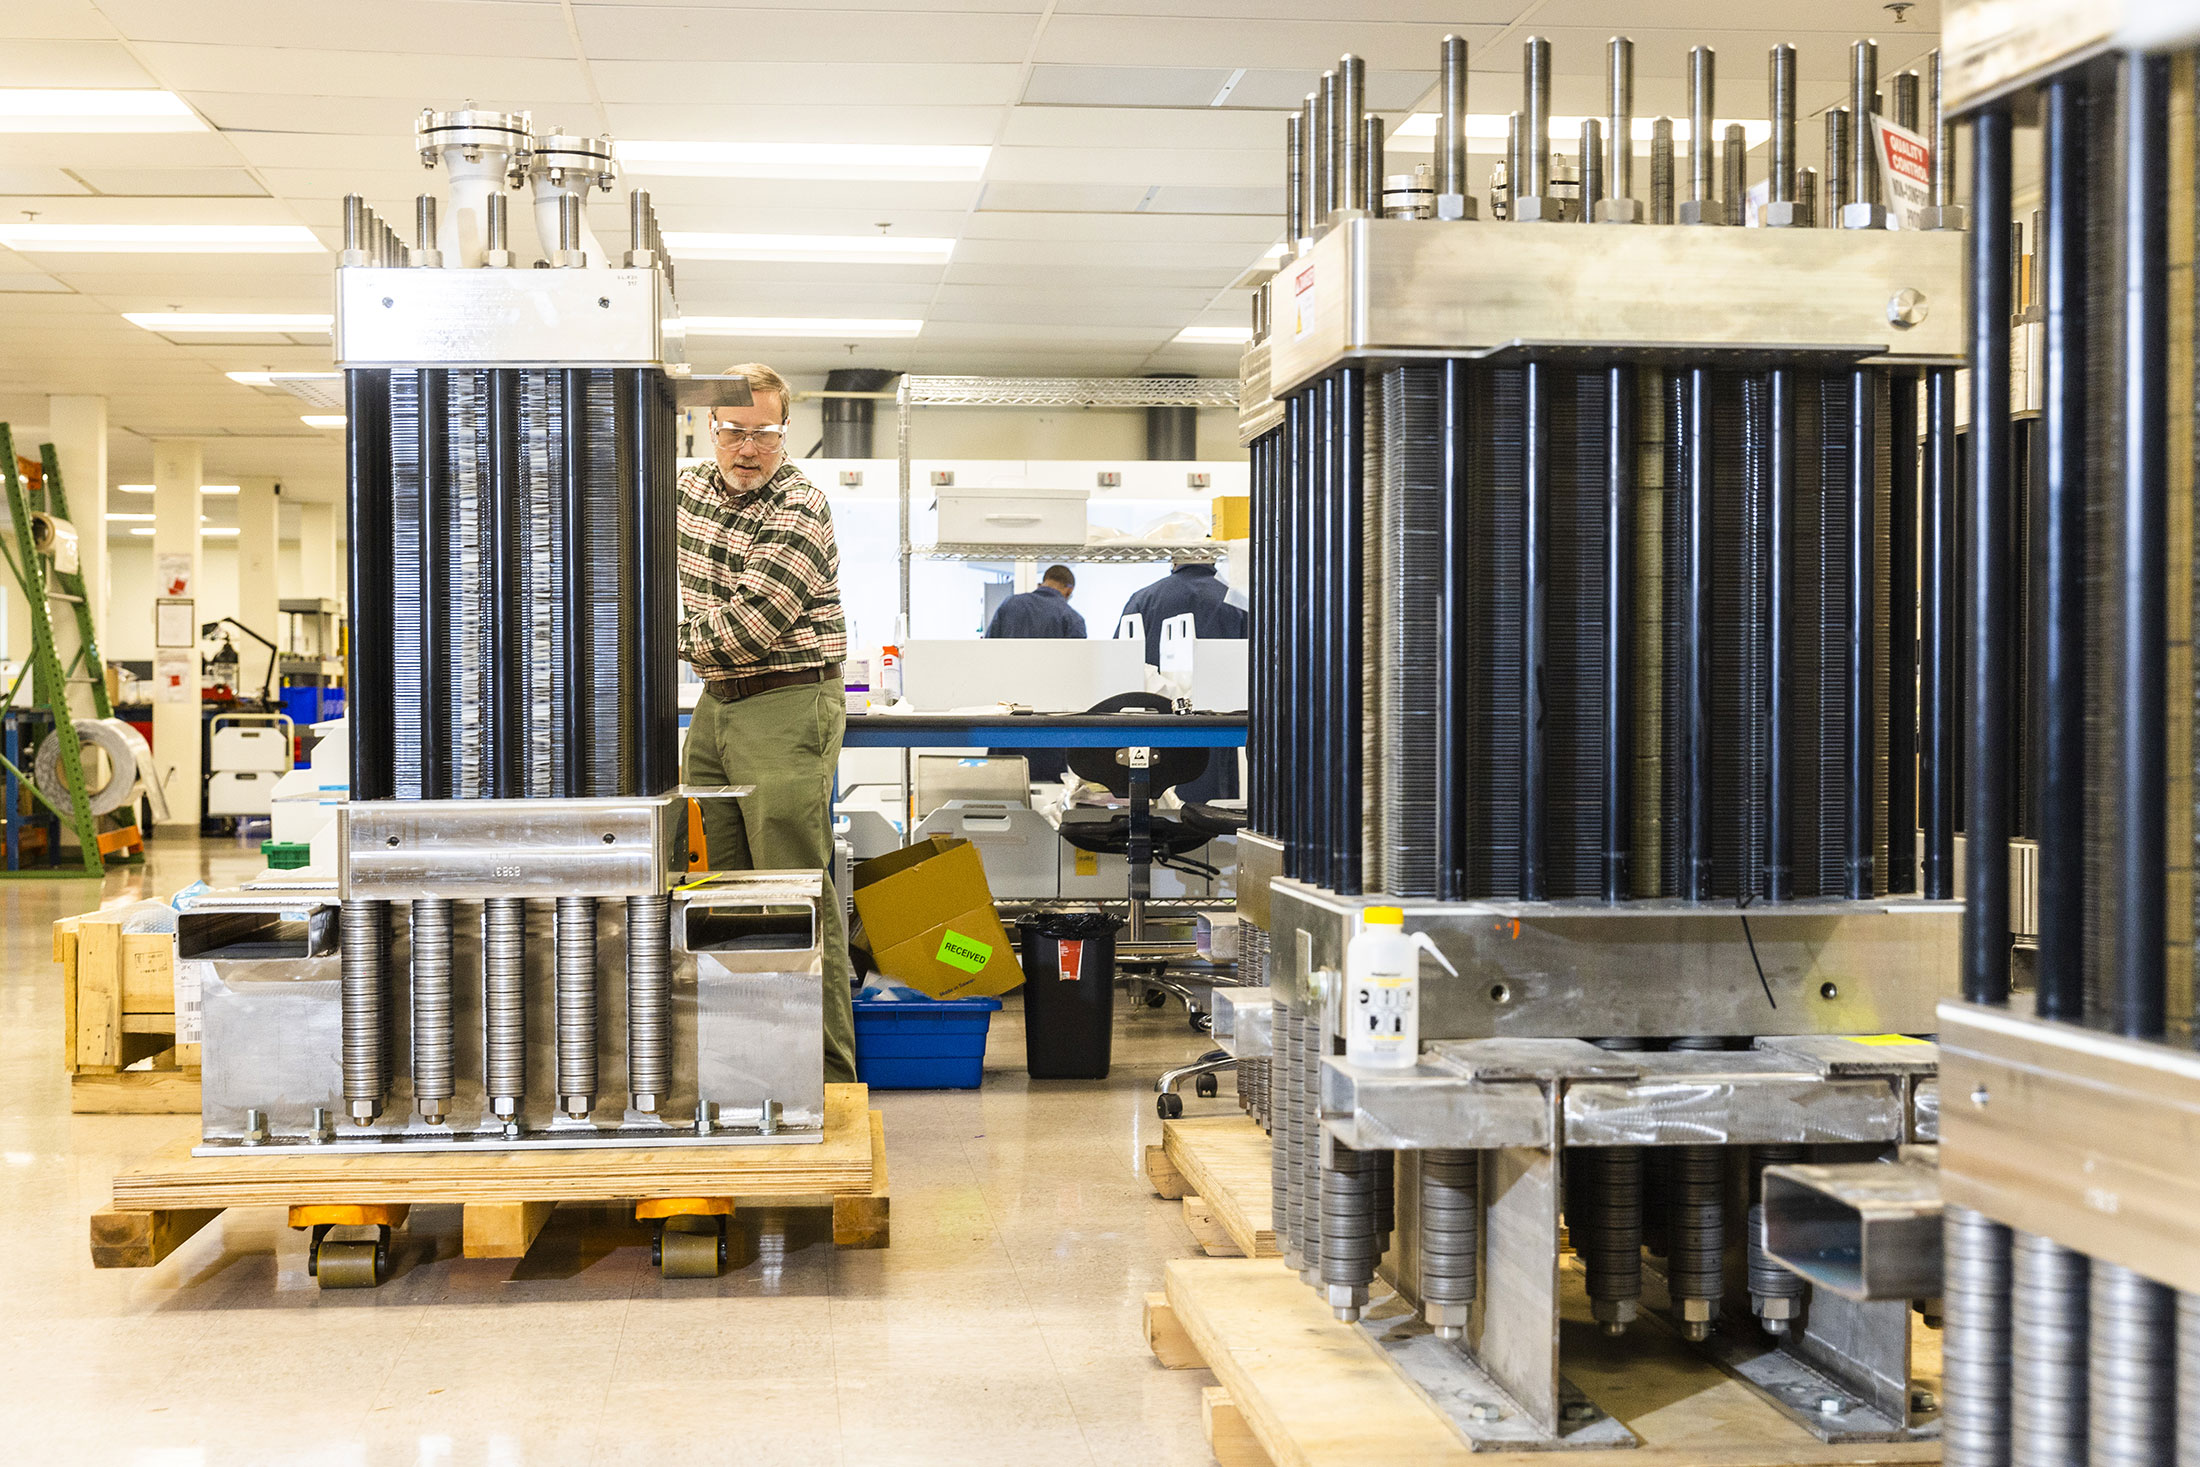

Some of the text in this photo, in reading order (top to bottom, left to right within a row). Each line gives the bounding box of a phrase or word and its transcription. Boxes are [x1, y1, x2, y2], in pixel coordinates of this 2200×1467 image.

[1889, 135, 1923, 162] QUALITY
[1892, 154, 1929, 182] CONTROL
[944, 942, 986, 964] RECEIVED
